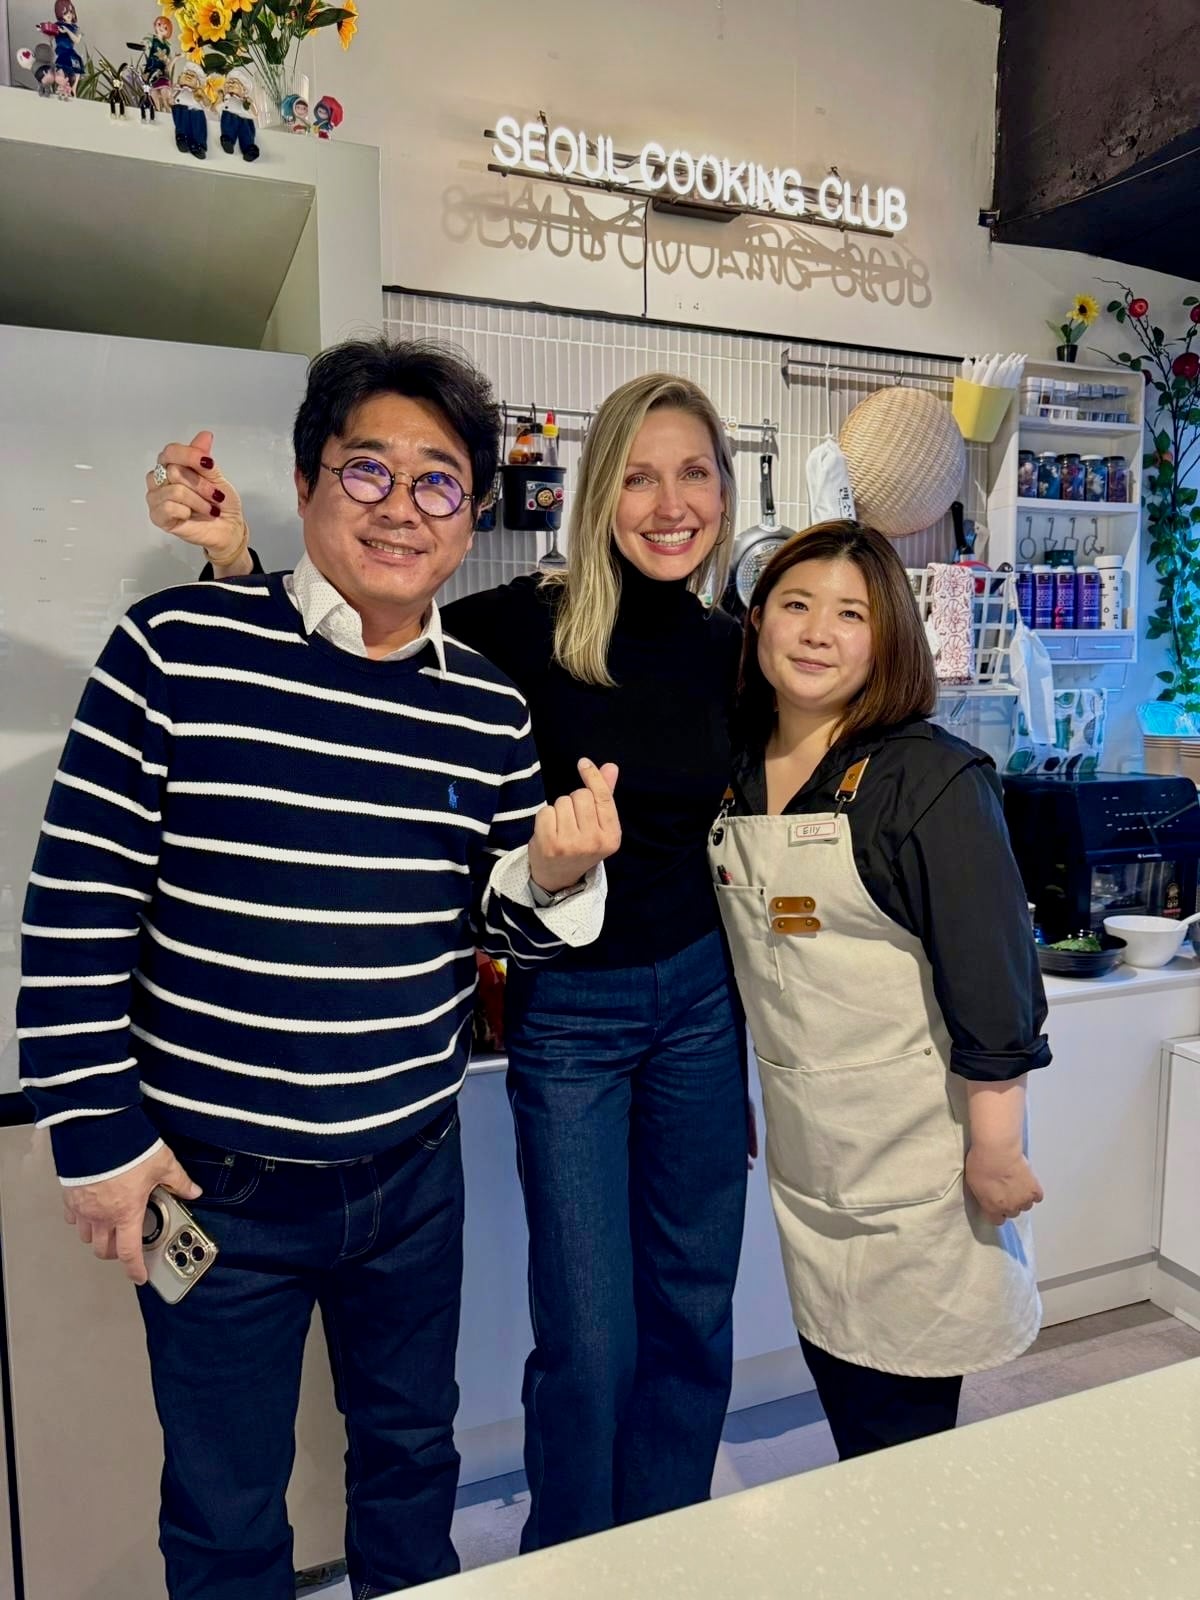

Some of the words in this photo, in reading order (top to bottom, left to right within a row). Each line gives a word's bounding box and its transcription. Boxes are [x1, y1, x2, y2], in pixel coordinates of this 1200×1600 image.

[492, 115, 630, 184] SEOUL
[639, 142, 804, 216] COOKING
[818, 176, 908, 232] CLUB
[802, 826, 821, 835] Elly
